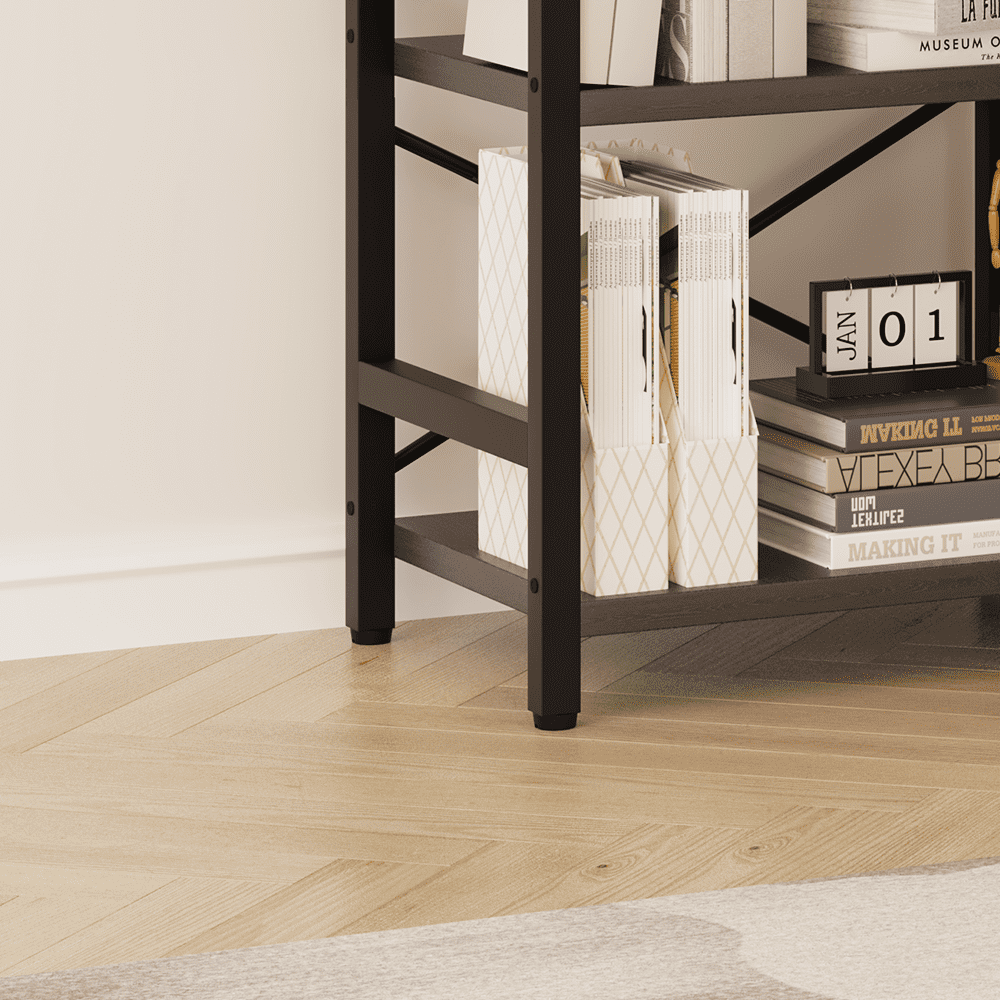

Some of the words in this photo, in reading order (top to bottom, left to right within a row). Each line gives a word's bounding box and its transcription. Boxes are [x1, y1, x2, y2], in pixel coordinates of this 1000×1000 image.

[919, 37, 984, 52] MUSEUM
[981, 53, 995, 61] The
[837, 311, 858, 361] JAN
[847, 533, 935, 562] MAKING
[939, 531, 963, 552] IT
